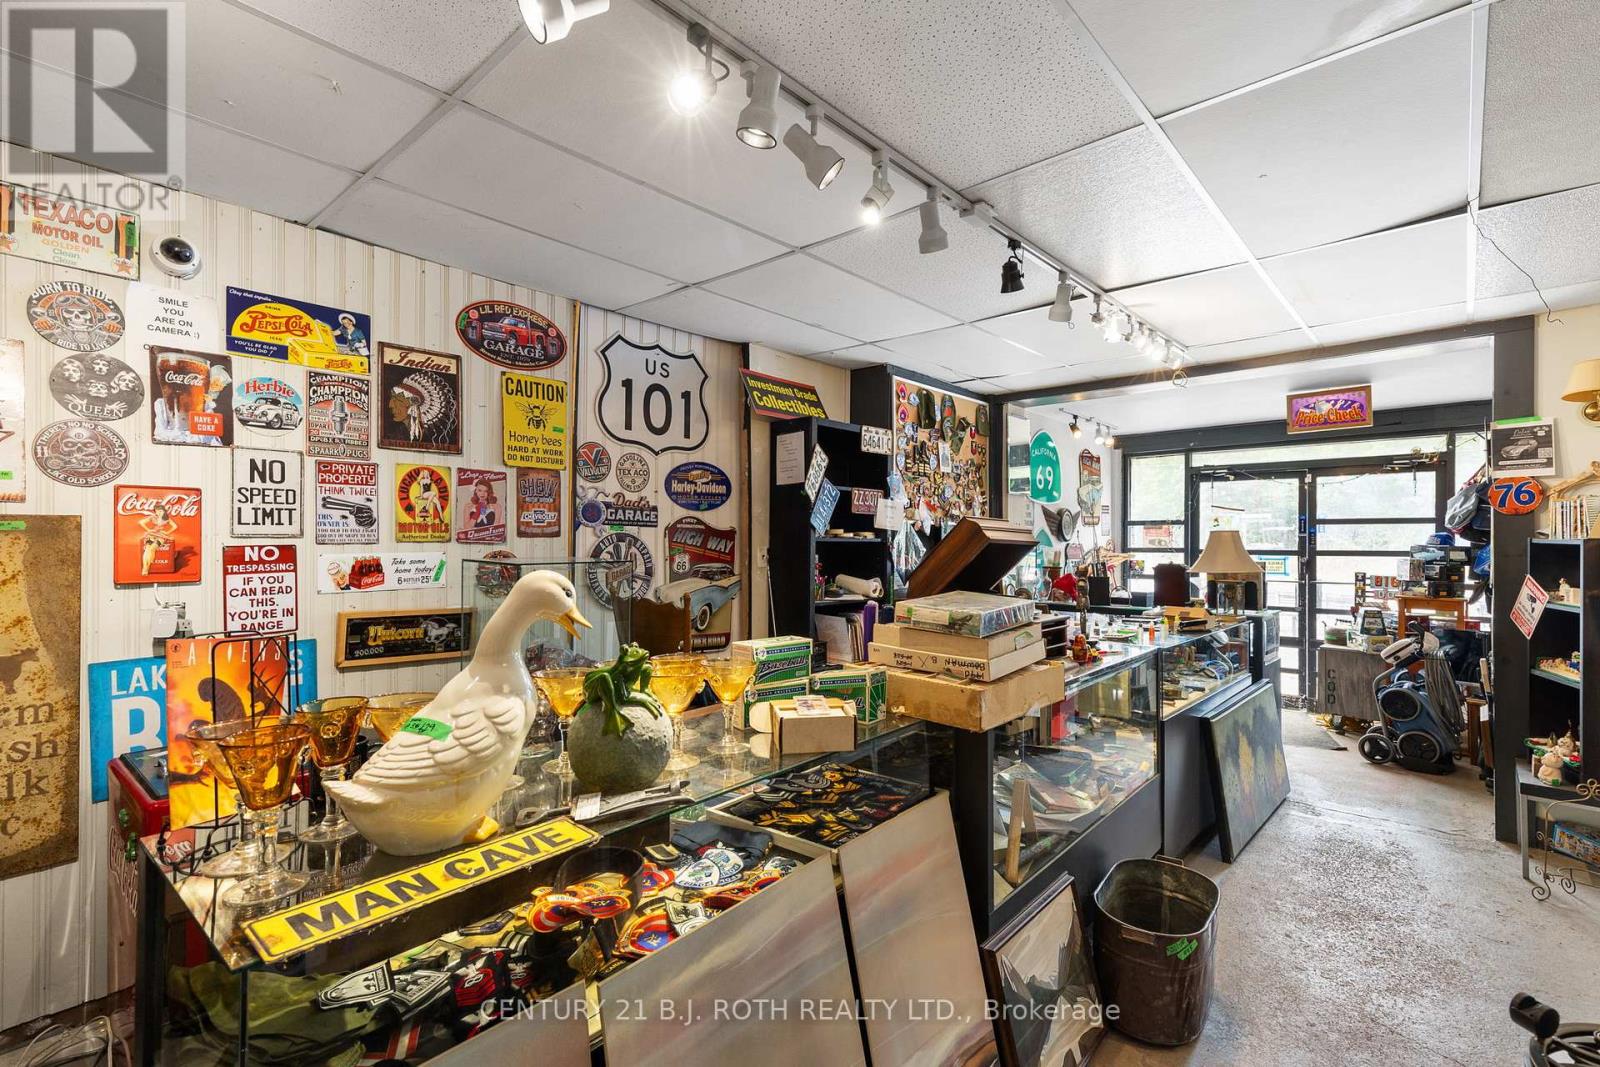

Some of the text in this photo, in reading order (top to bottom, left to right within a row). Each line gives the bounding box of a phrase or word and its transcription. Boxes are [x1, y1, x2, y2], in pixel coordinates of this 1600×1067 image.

[17, 191, 114, 234] TEXACO
[31, 222, 104, 249] MOTOR OIL
[63, 282, 80, 292] TO
[84, 284, 113, 303] RIDE
[158, 296, 189, 308] SMILE
[162, 307, 185, 317] YOU
[480, 305, 549, 329] LIL RED EXPRESS
[154, 315, 194, 328] ARE ON
[147, 324, 192, 338] CAMERA
[56, 338, 79, 350] RIDE
[79, 343, 91, 351] TO
[234, 339, 254, 348] YOU'LL
[483, 339, 545, 359] GARAGE
[389, 350, 452, 374] Indian
[645, 358, 670, 379] US
[164, 370, 205, 387] Coca-Cola
[245, 378, 295, 398] Herbie
[505, 376, 565, 404] CAUTION
[747, 376, 818, 402] Investment Grade
[309, 394, 335, 406] SPARK
[751, 390, 826, 419] Collectibles
[68, 401, 125, 420] QUEEN
[621, 377, 692, 440] 101
[1295, 403, 1364, 425] Price Check
[193, 414, 219, 426] HAVE A
[197, 423, 216, 433] COKE
[508, 431, 562, 447] Honey bees
[507, 445, 564, 456] HARD AT WORK
[1031, 447, 1058, 463] CALIFORNIA
[519, 454, 534, 463] NOT
[535, 456, 564, 466] DISTURB
[619, 454, 647, 468] GASOLINE
[249, 457, 286, 484] NO
[332, 463, 375, 476] PRIVATE
[1036, 464, 1055, 491] 69
[67, 476, 86, 484] OLD
[318, 473, 376, 485] PROPERTY
[633, 477, 648, 490] STATION
[318, 485, 345, 496] THINK
[519, 477, 560, 498] CHEVY
[671, 479, 727, 496] Harley-Davidson
[1494, 480, 1536, 508] 76
[237, 487, 297, 506] SPEED
[613, 491, 651, 509] Dad's
[117, 492, 203, 518] Coca-Cola
[237, 506, 297, 526] LIMIT
[317, 513, 333, 521] THIS
[607, 508, 658, 522] GARAGE
[317, 520, 341, 528] OWNER
[398, 522, 428, 533] MOTOR
[672, 528, 734, 554] HIGH WAY
[243, 545, 281, 562] NO
[599, 534, 618, 550] AUTO
[635, 540, 653, 568] REPAIR
[226, 563, 295, 573] TRESPASSING
[391, 557, 407, 566] Take
[394, 564, 436, 575] home today!
[676, 560, 687, 571] 66
[242, 575, 285, 587] IF YOU
[360, 572, 385, 586] Coca-Cola
[397, 576, 403, 585] 6
[229, 585, 293, 598] CAN READ
[248, 597, 280, 608] THIS.
[228, 607, 295, 622] YOU'RE IN
[240, 620, 285, 632] RANGE
[366, 624, 426, 646] Unicorn
[187, 637, 283, 666] ALIENS
[759, 655, 808, 672] Baseball
[285, 827, 575, 940] MAN CAVE
